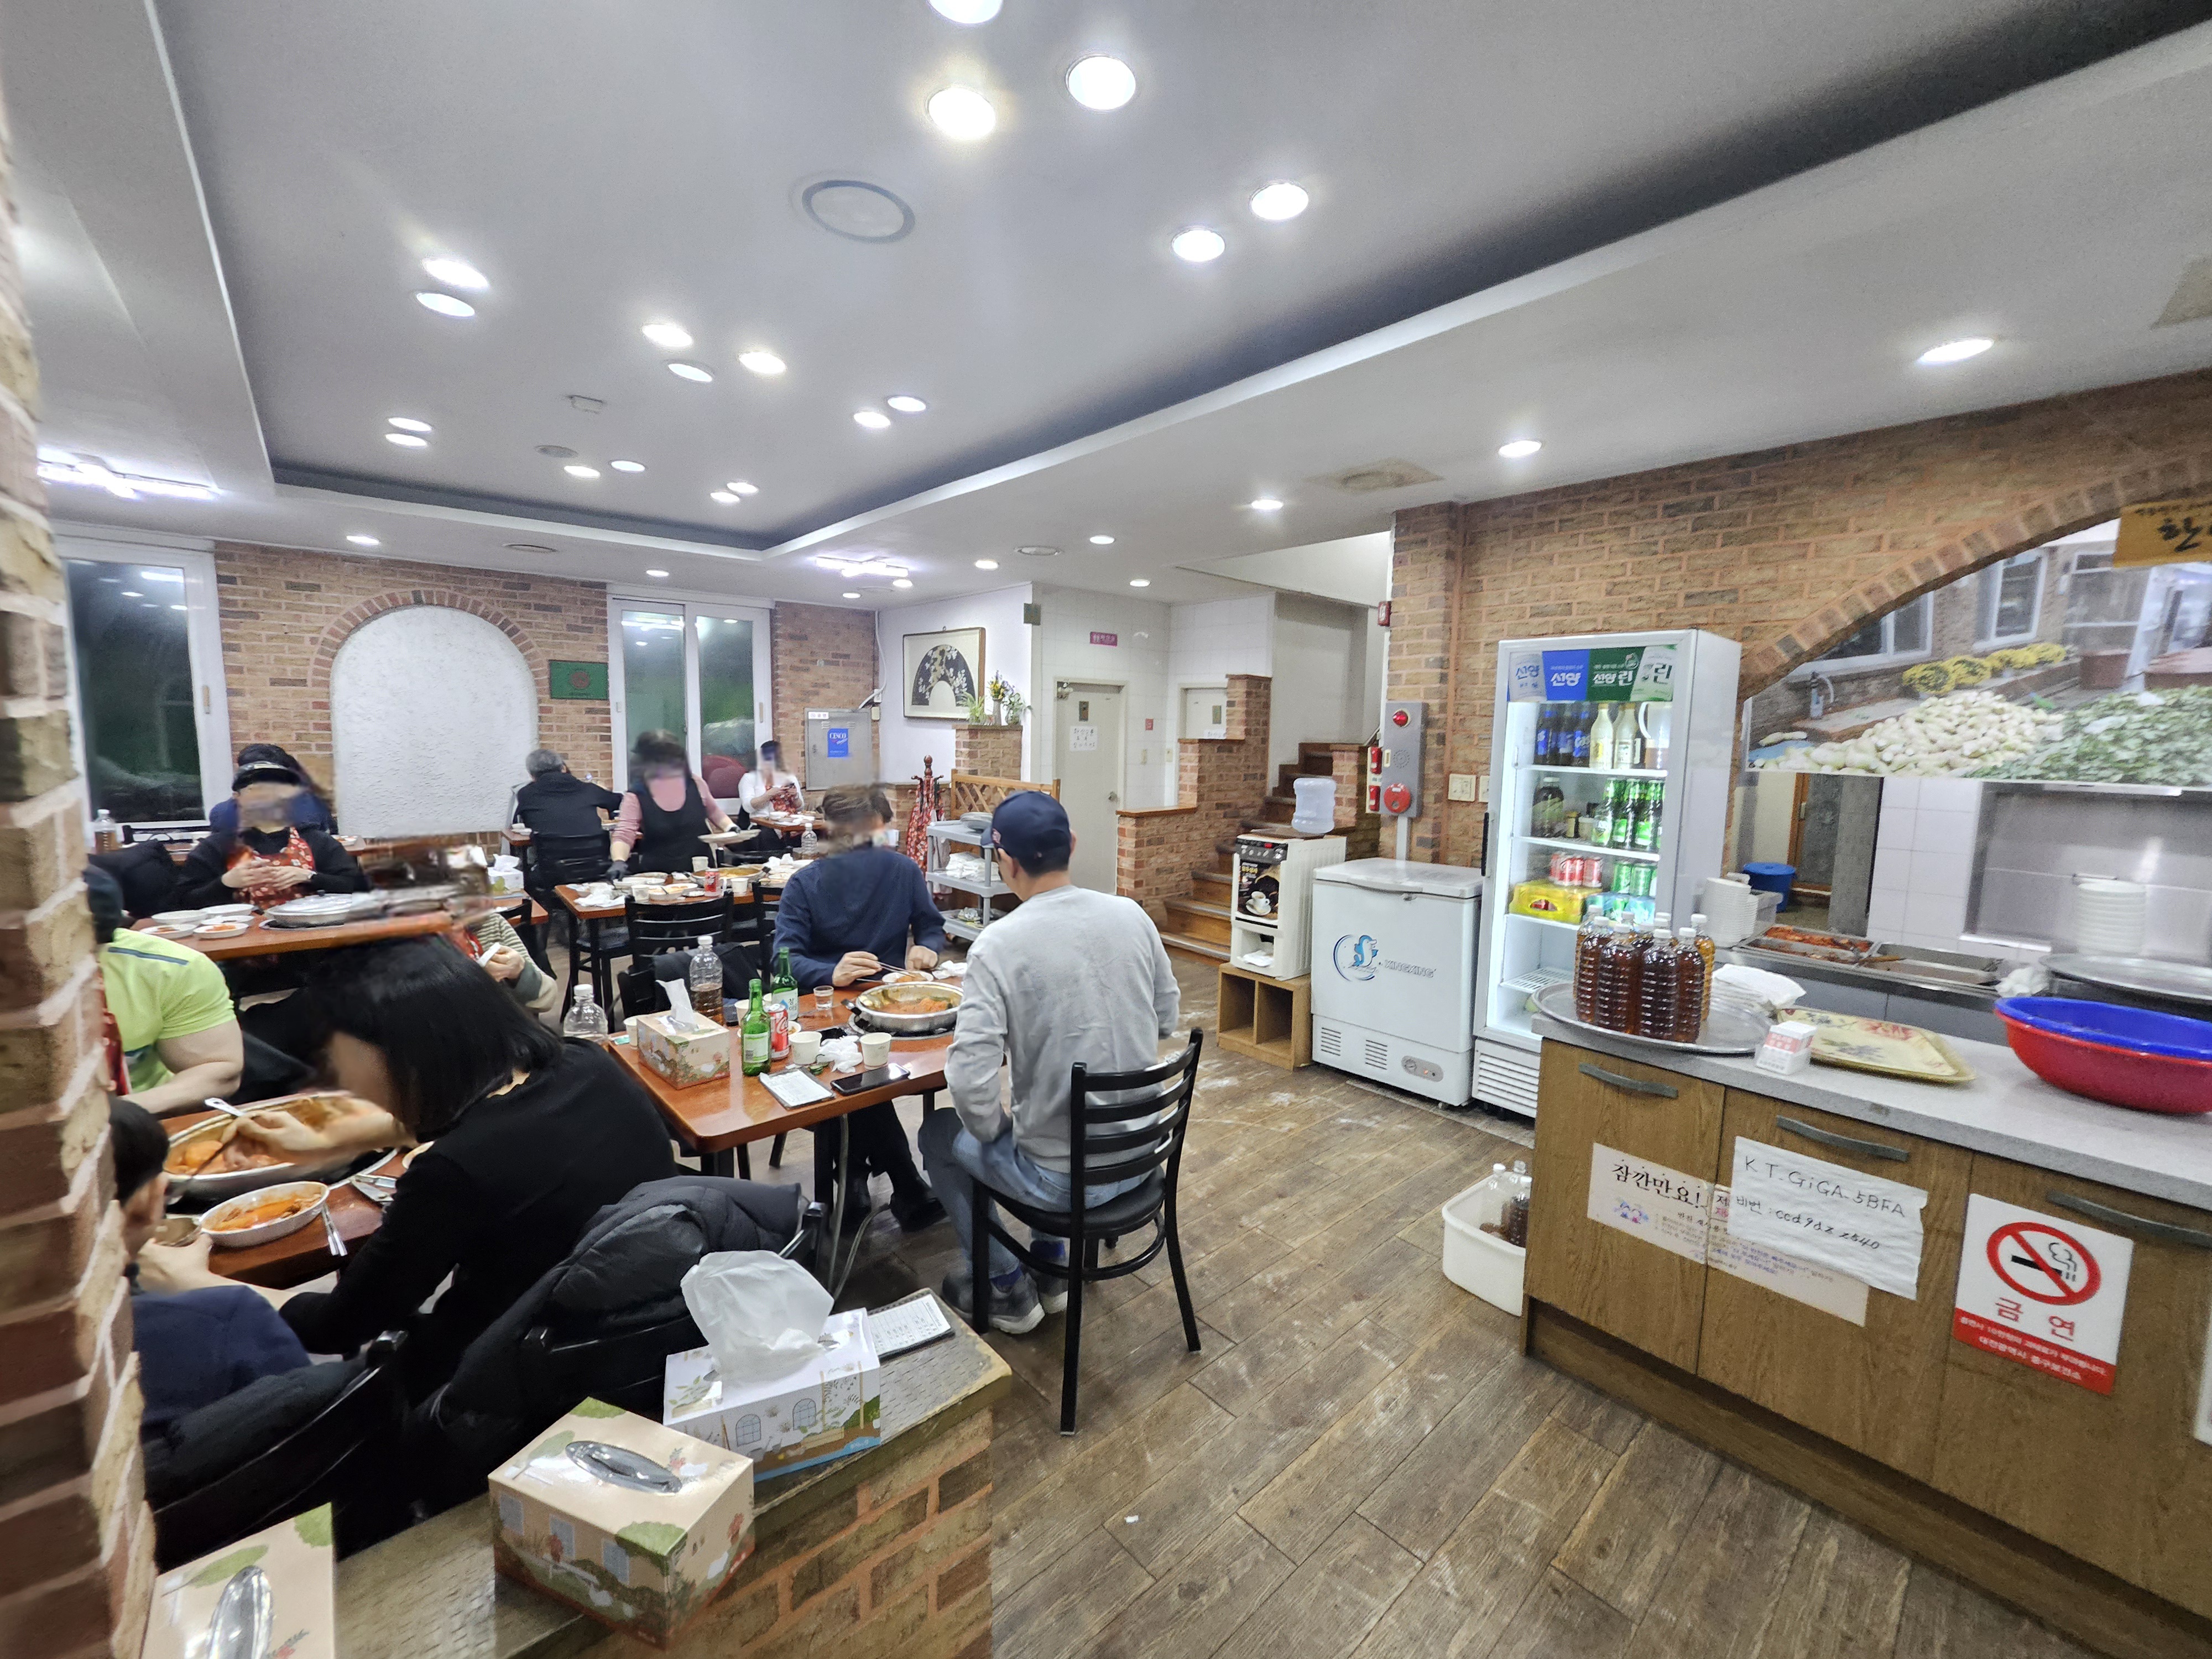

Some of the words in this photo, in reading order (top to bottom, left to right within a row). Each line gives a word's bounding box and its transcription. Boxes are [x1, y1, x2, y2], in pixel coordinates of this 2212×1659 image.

[1516, 665, 1540, 680] 선양
[1551, 672, 1581, 686] 선양
[1592, 672, 1616, 685] 선양
[1618, 670, 1633, 686] 린
[1613, 1162, 1700, 1208] 잠깐만요!
[1736, 1196, 1762, 1215] 비번
